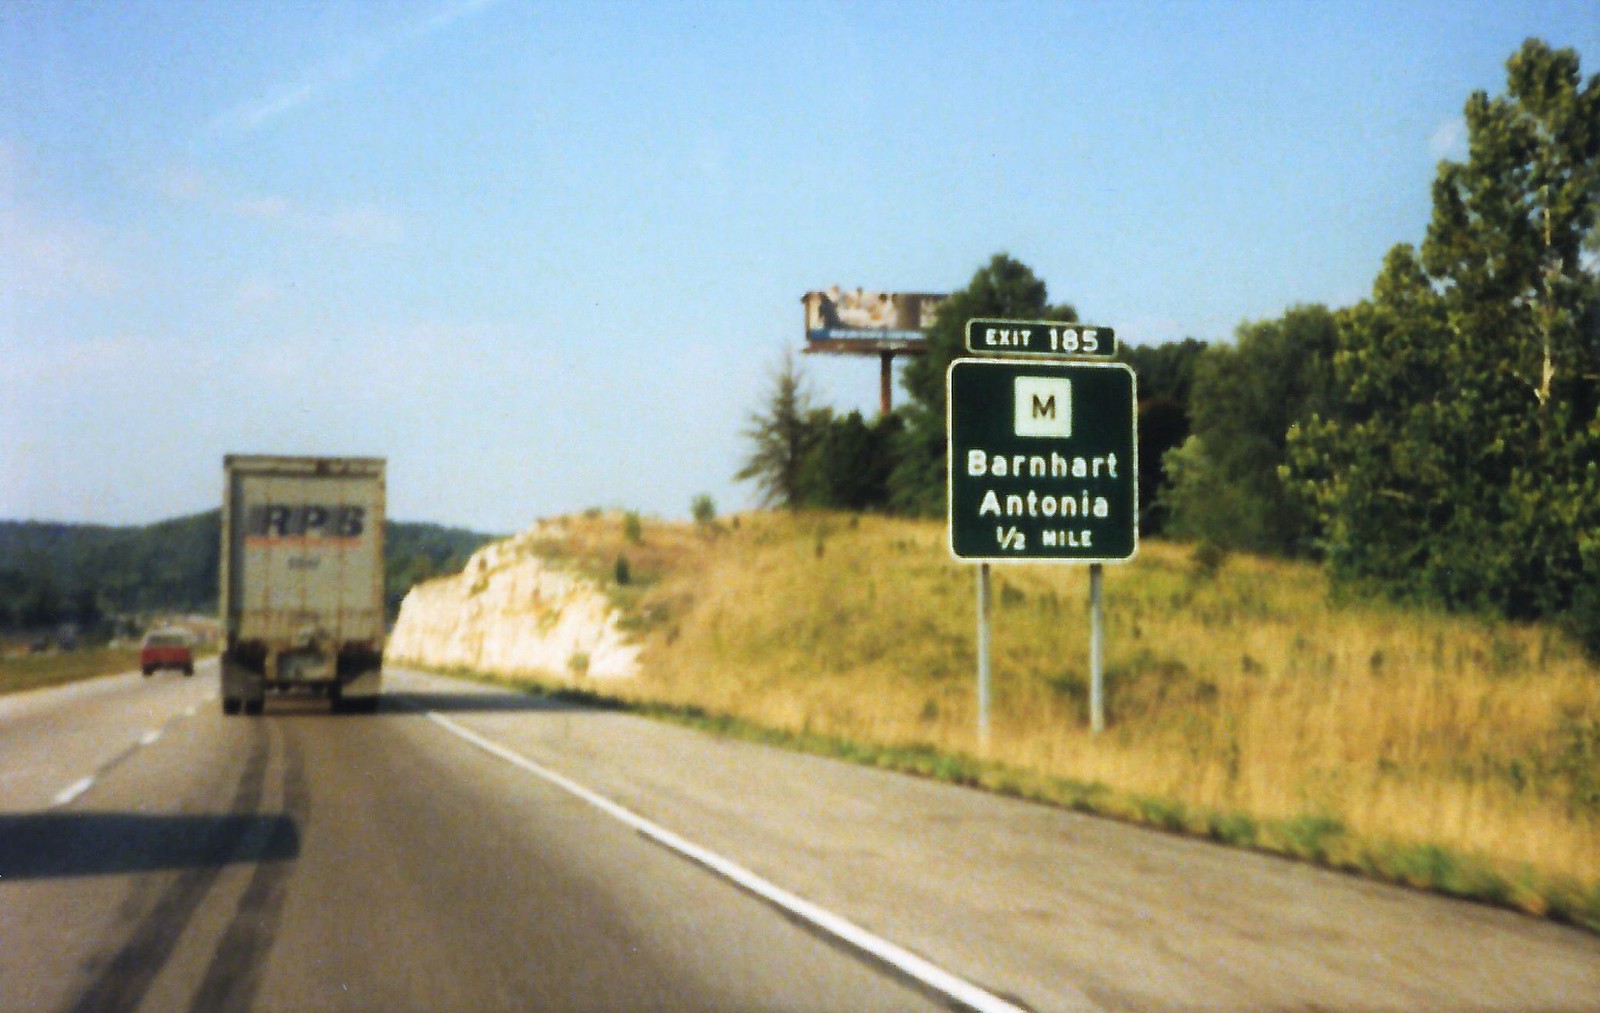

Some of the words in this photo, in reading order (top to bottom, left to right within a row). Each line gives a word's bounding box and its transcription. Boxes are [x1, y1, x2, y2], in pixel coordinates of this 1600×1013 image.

[985, 328, 1031, 346] EXIT
[1049, 328, 1099, 352] 185
[1032, 394, 1056, 419] M
[967, 449, 1118, 478] Barnhart
[979, 489, 1109, 518] Antonia
[250, 505, 365, 537] RPS
[1042, 529, 1092, 547] MILE
